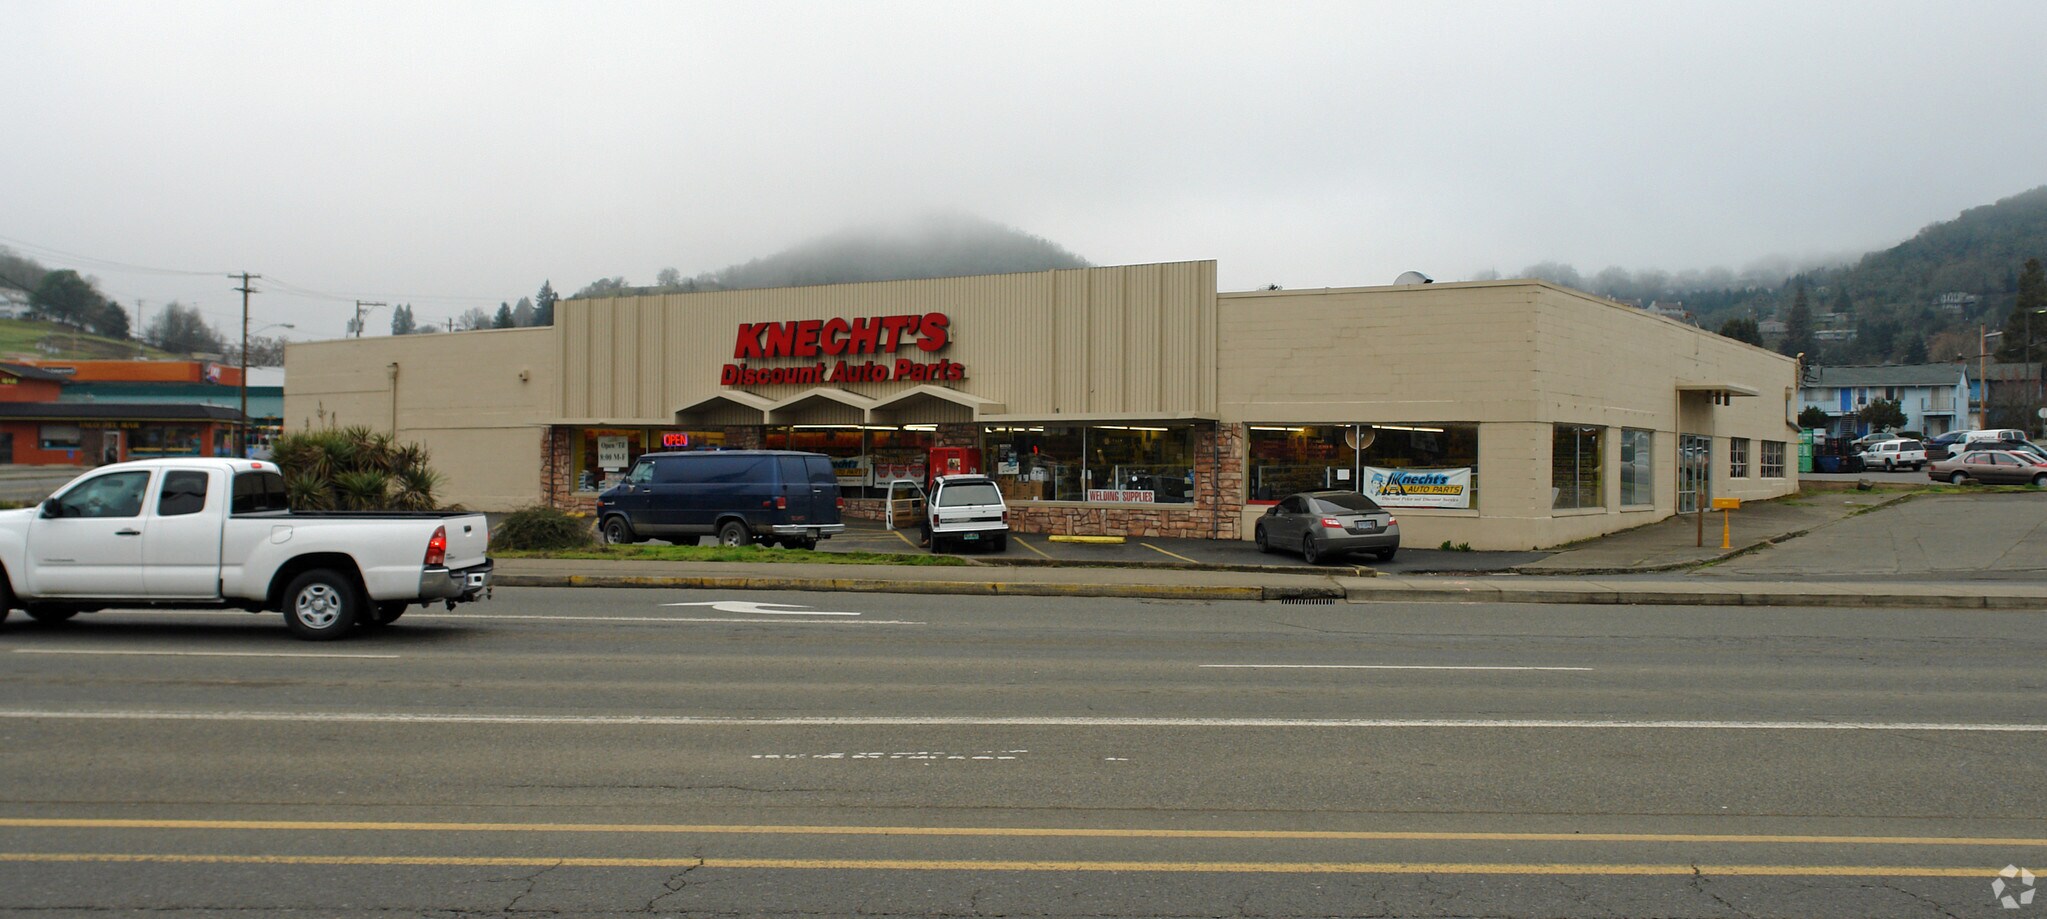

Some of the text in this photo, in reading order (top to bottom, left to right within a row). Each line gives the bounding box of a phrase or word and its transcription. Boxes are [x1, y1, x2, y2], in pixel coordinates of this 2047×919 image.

[734, 312, 950, 359] KNECHT'S
[721, 357, 965, 386] Discount Auto Parts
[601, 442, 615, 450] Open
[664, 434, 688, 446] OPEN
[1383, 472, 1449, 495] Knecht's
[1090, 491, 1153, 503] WELDING SUPPLIES
